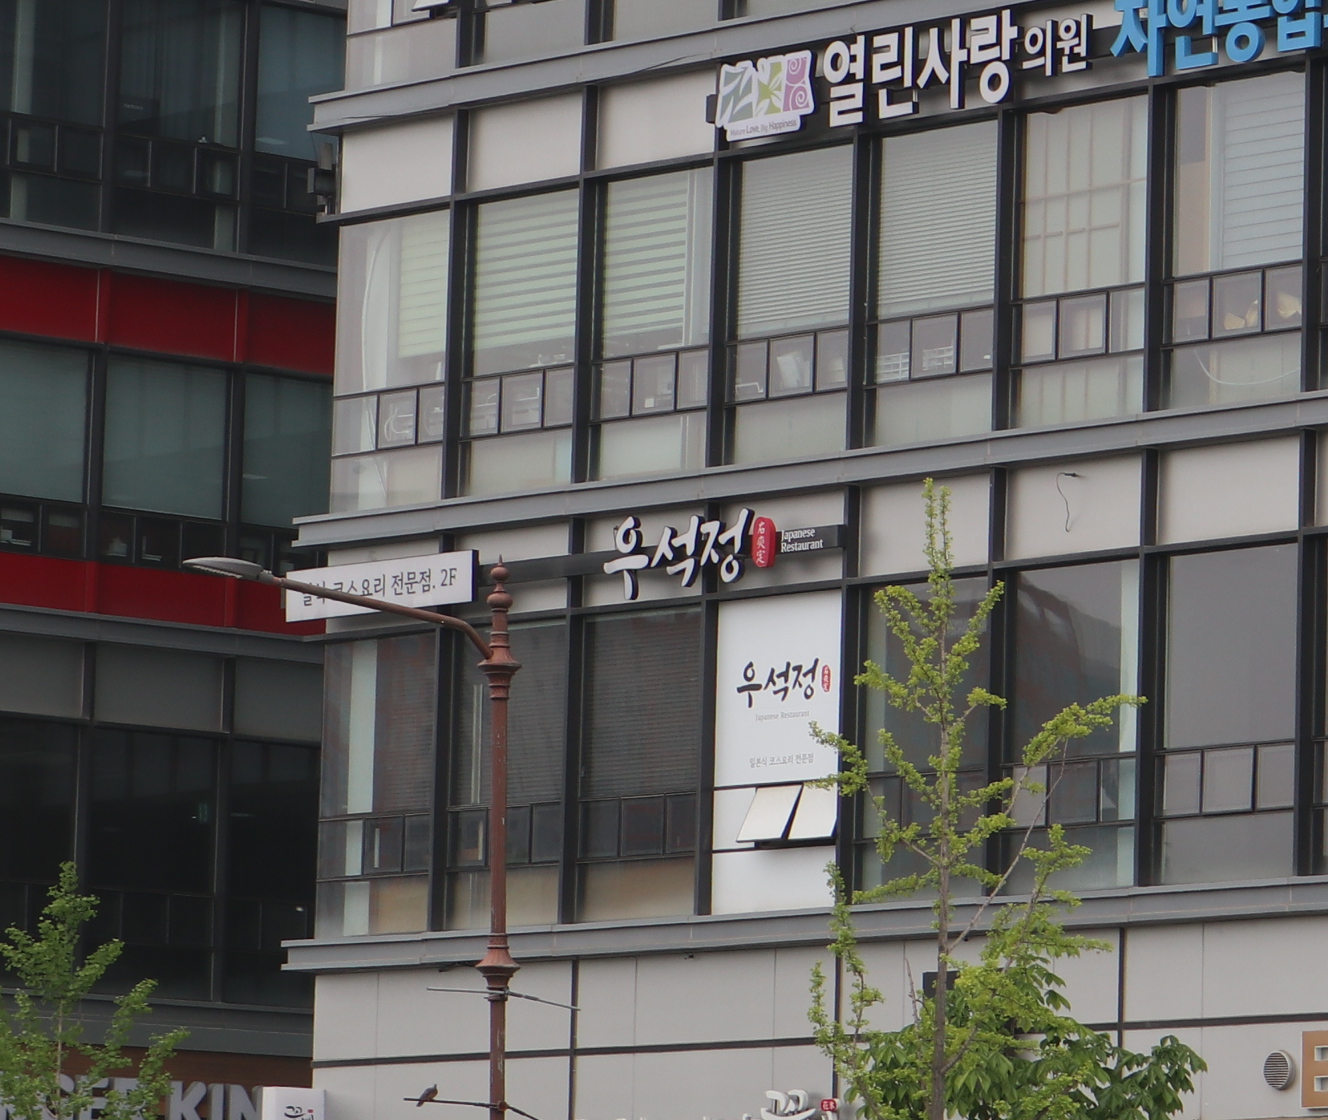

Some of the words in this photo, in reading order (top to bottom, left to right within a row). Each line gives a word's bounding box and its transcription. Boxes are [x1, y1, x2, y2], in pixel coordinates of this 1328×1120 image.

[781, 528, 815, 542] Japanese
[604, 509, 749, 599] 우석정
[781, 539, 823, 553] Restaurant
[441, 568, 457, 587] 2F
[737, 657, 819, 708] 우석정
